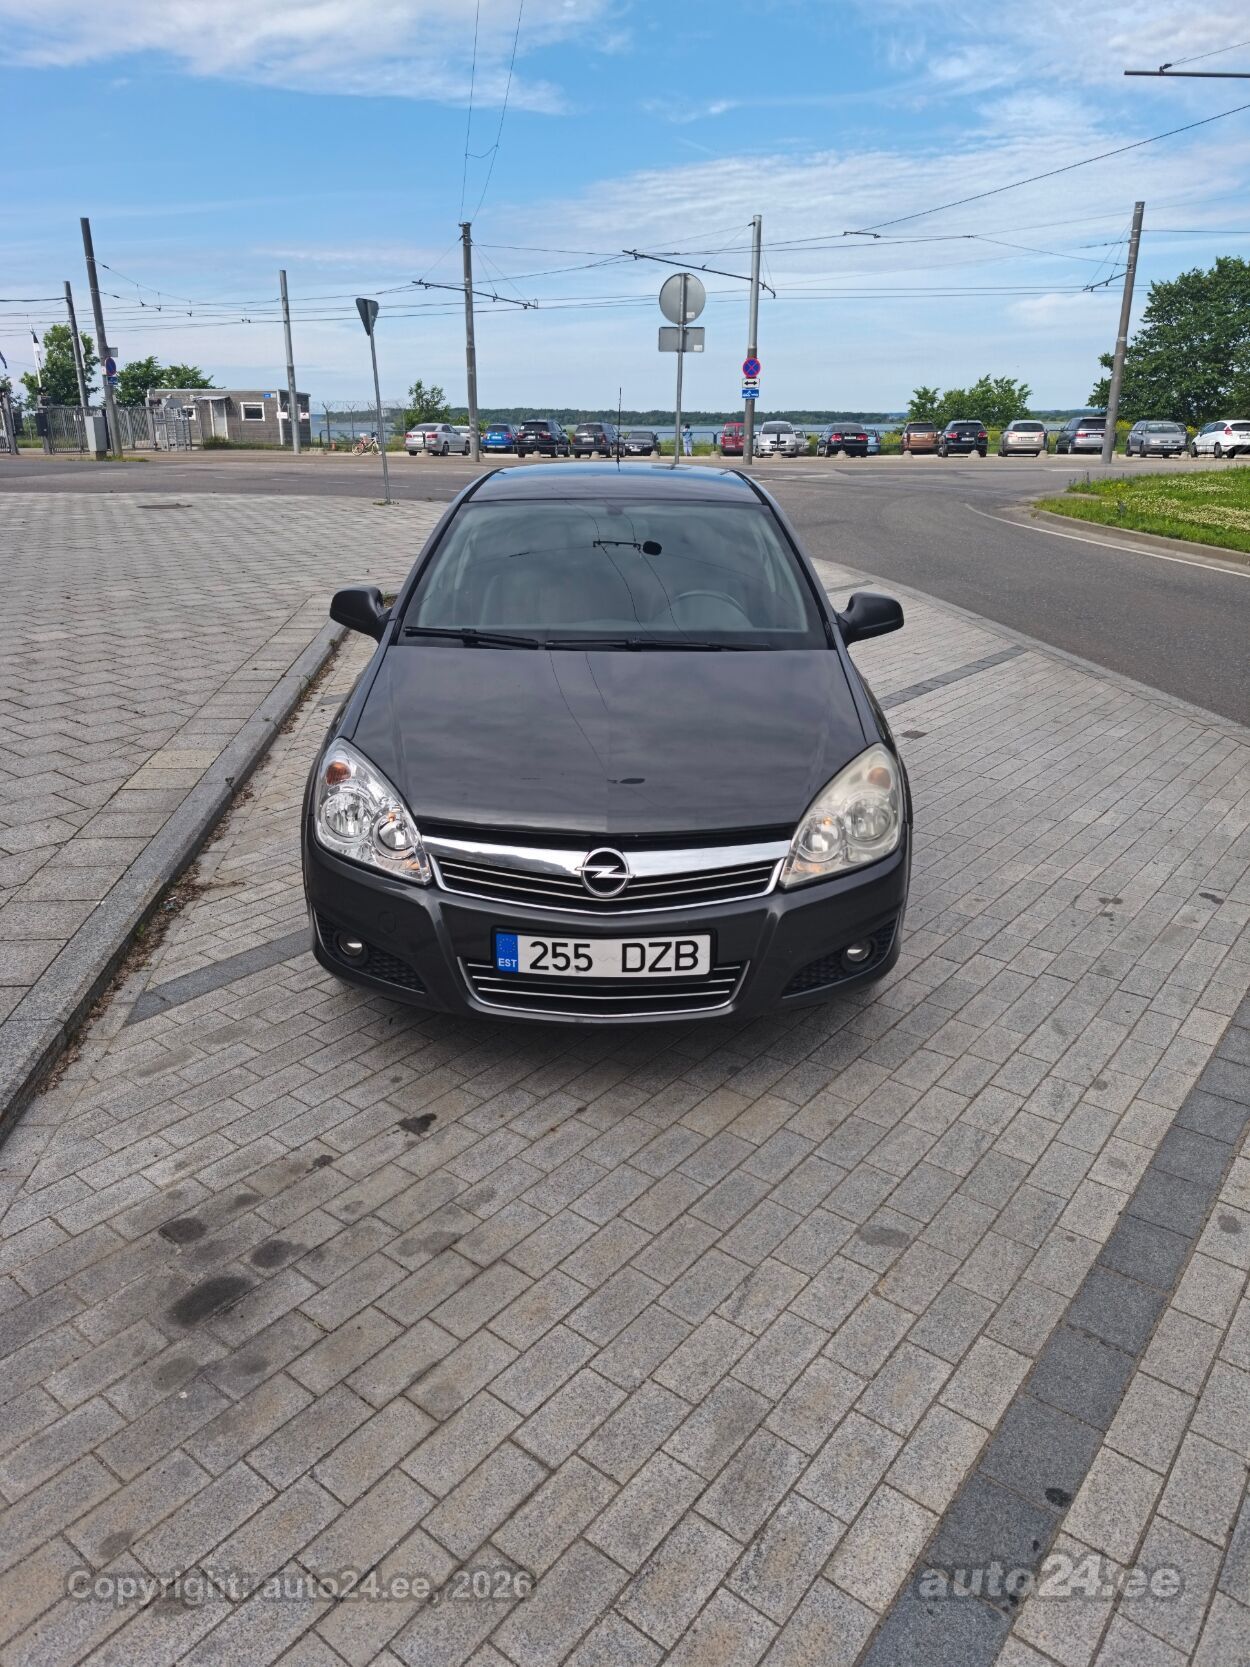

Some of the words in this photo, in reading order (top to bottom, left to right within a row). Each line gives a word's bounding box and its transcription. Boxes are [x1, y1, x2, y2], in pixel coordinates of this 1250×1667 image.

[499, 958, 517, 968] EST
[530, 941, 593, 972] 255
[621, 940, 699, 973] DZB
